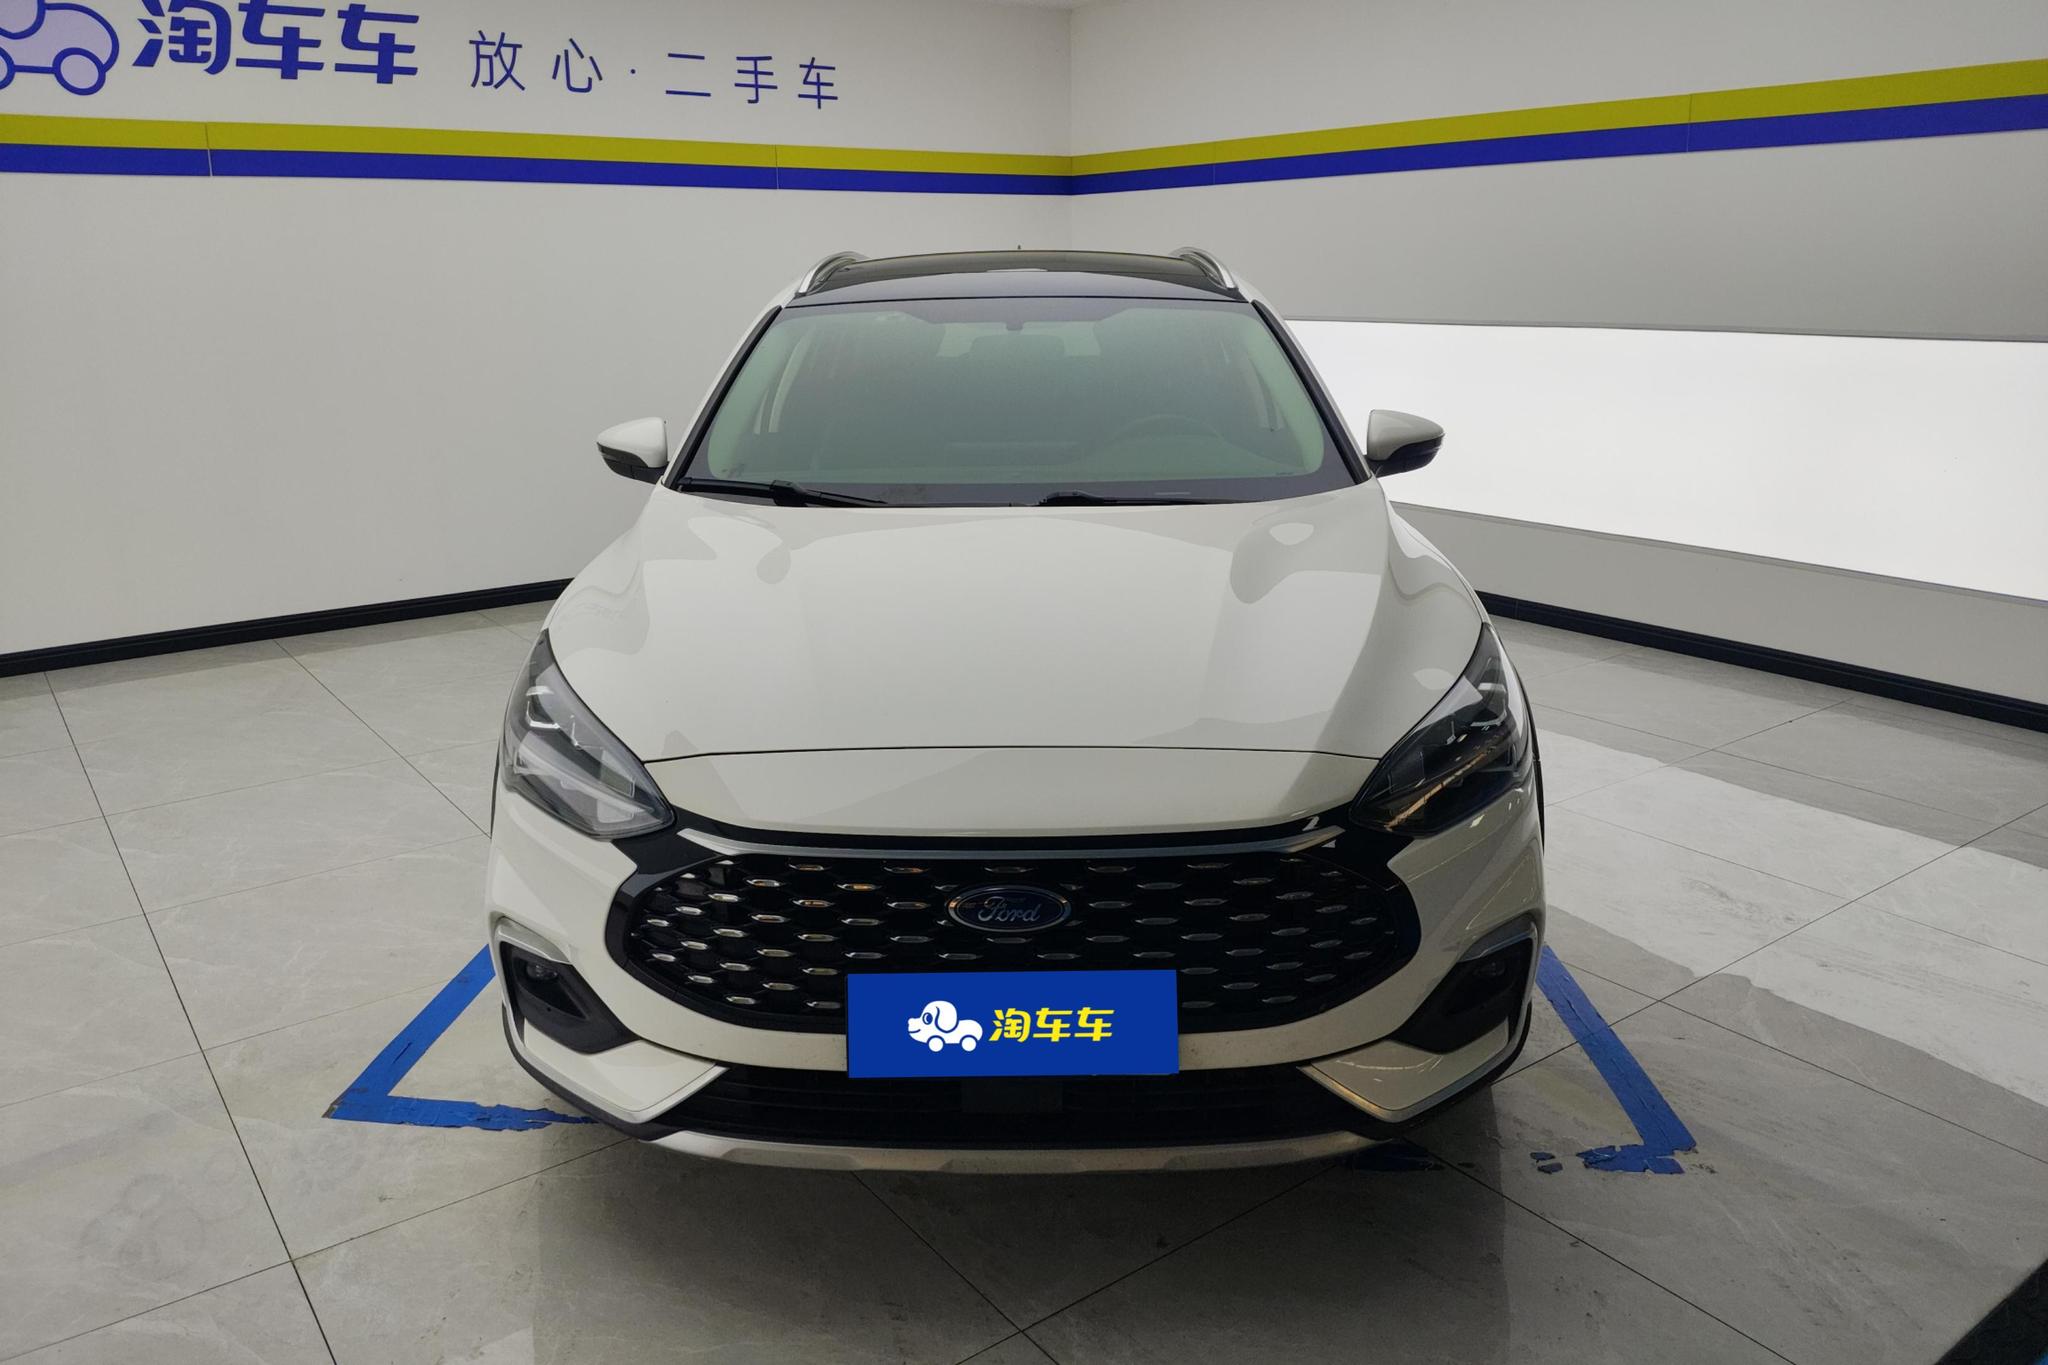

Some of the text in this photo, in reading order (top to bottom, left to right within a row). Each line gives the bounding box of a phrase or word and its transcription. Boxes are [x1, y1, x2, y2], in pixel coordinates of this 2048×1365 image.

[132, 0, 420, 84] 淘车车
[977, 895, 1042, 922] Ford
